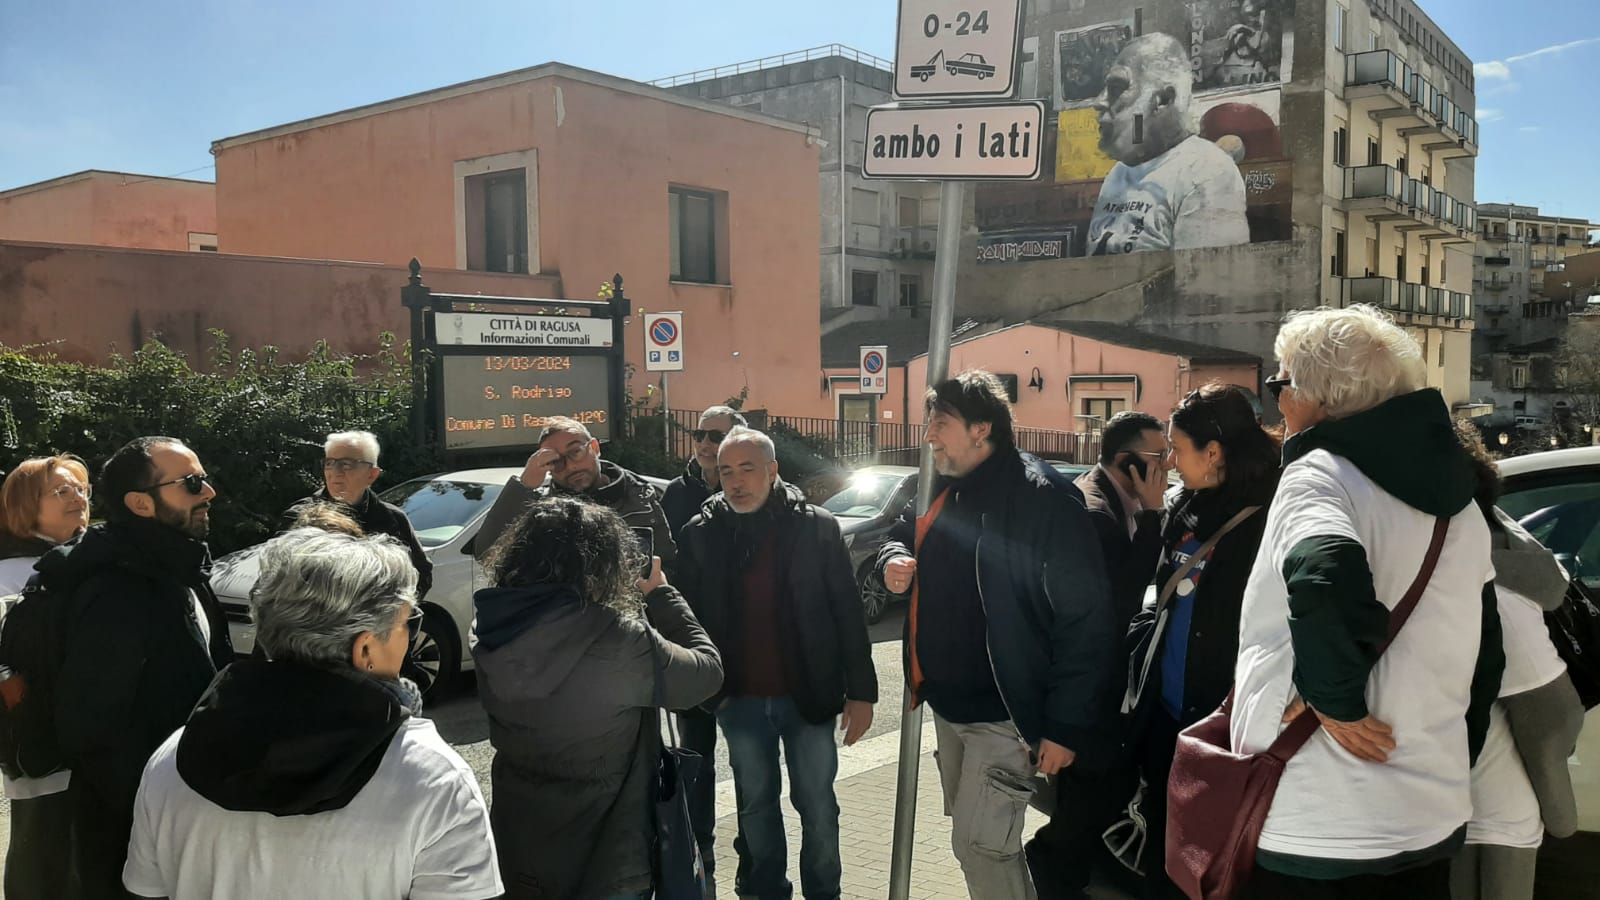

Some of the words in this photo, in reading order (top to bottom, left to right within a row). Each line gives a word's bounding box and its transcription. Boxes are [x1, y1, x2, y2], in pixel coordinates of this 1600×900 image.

[923, 10, 989, 38] 0-24
[872, 124, 940, 159] ambo
[955, 123, 963, 158] i
[978, 121, 1031, 158] lati
[489, 317, 522, 331] CITTÀ
[525, 321, 538, 331] DI
[540, 321, 581, 332] RAGUSA
[480, 332, 544, 344] Informazioni
[546, 334, 591, 345] Comunali
[484, 356, 571, 371] 13/03/2024
[484, 385, 501, 400] S.
[446, 416, 496, 432] Comune
[501, 414, 517, 428] Di
